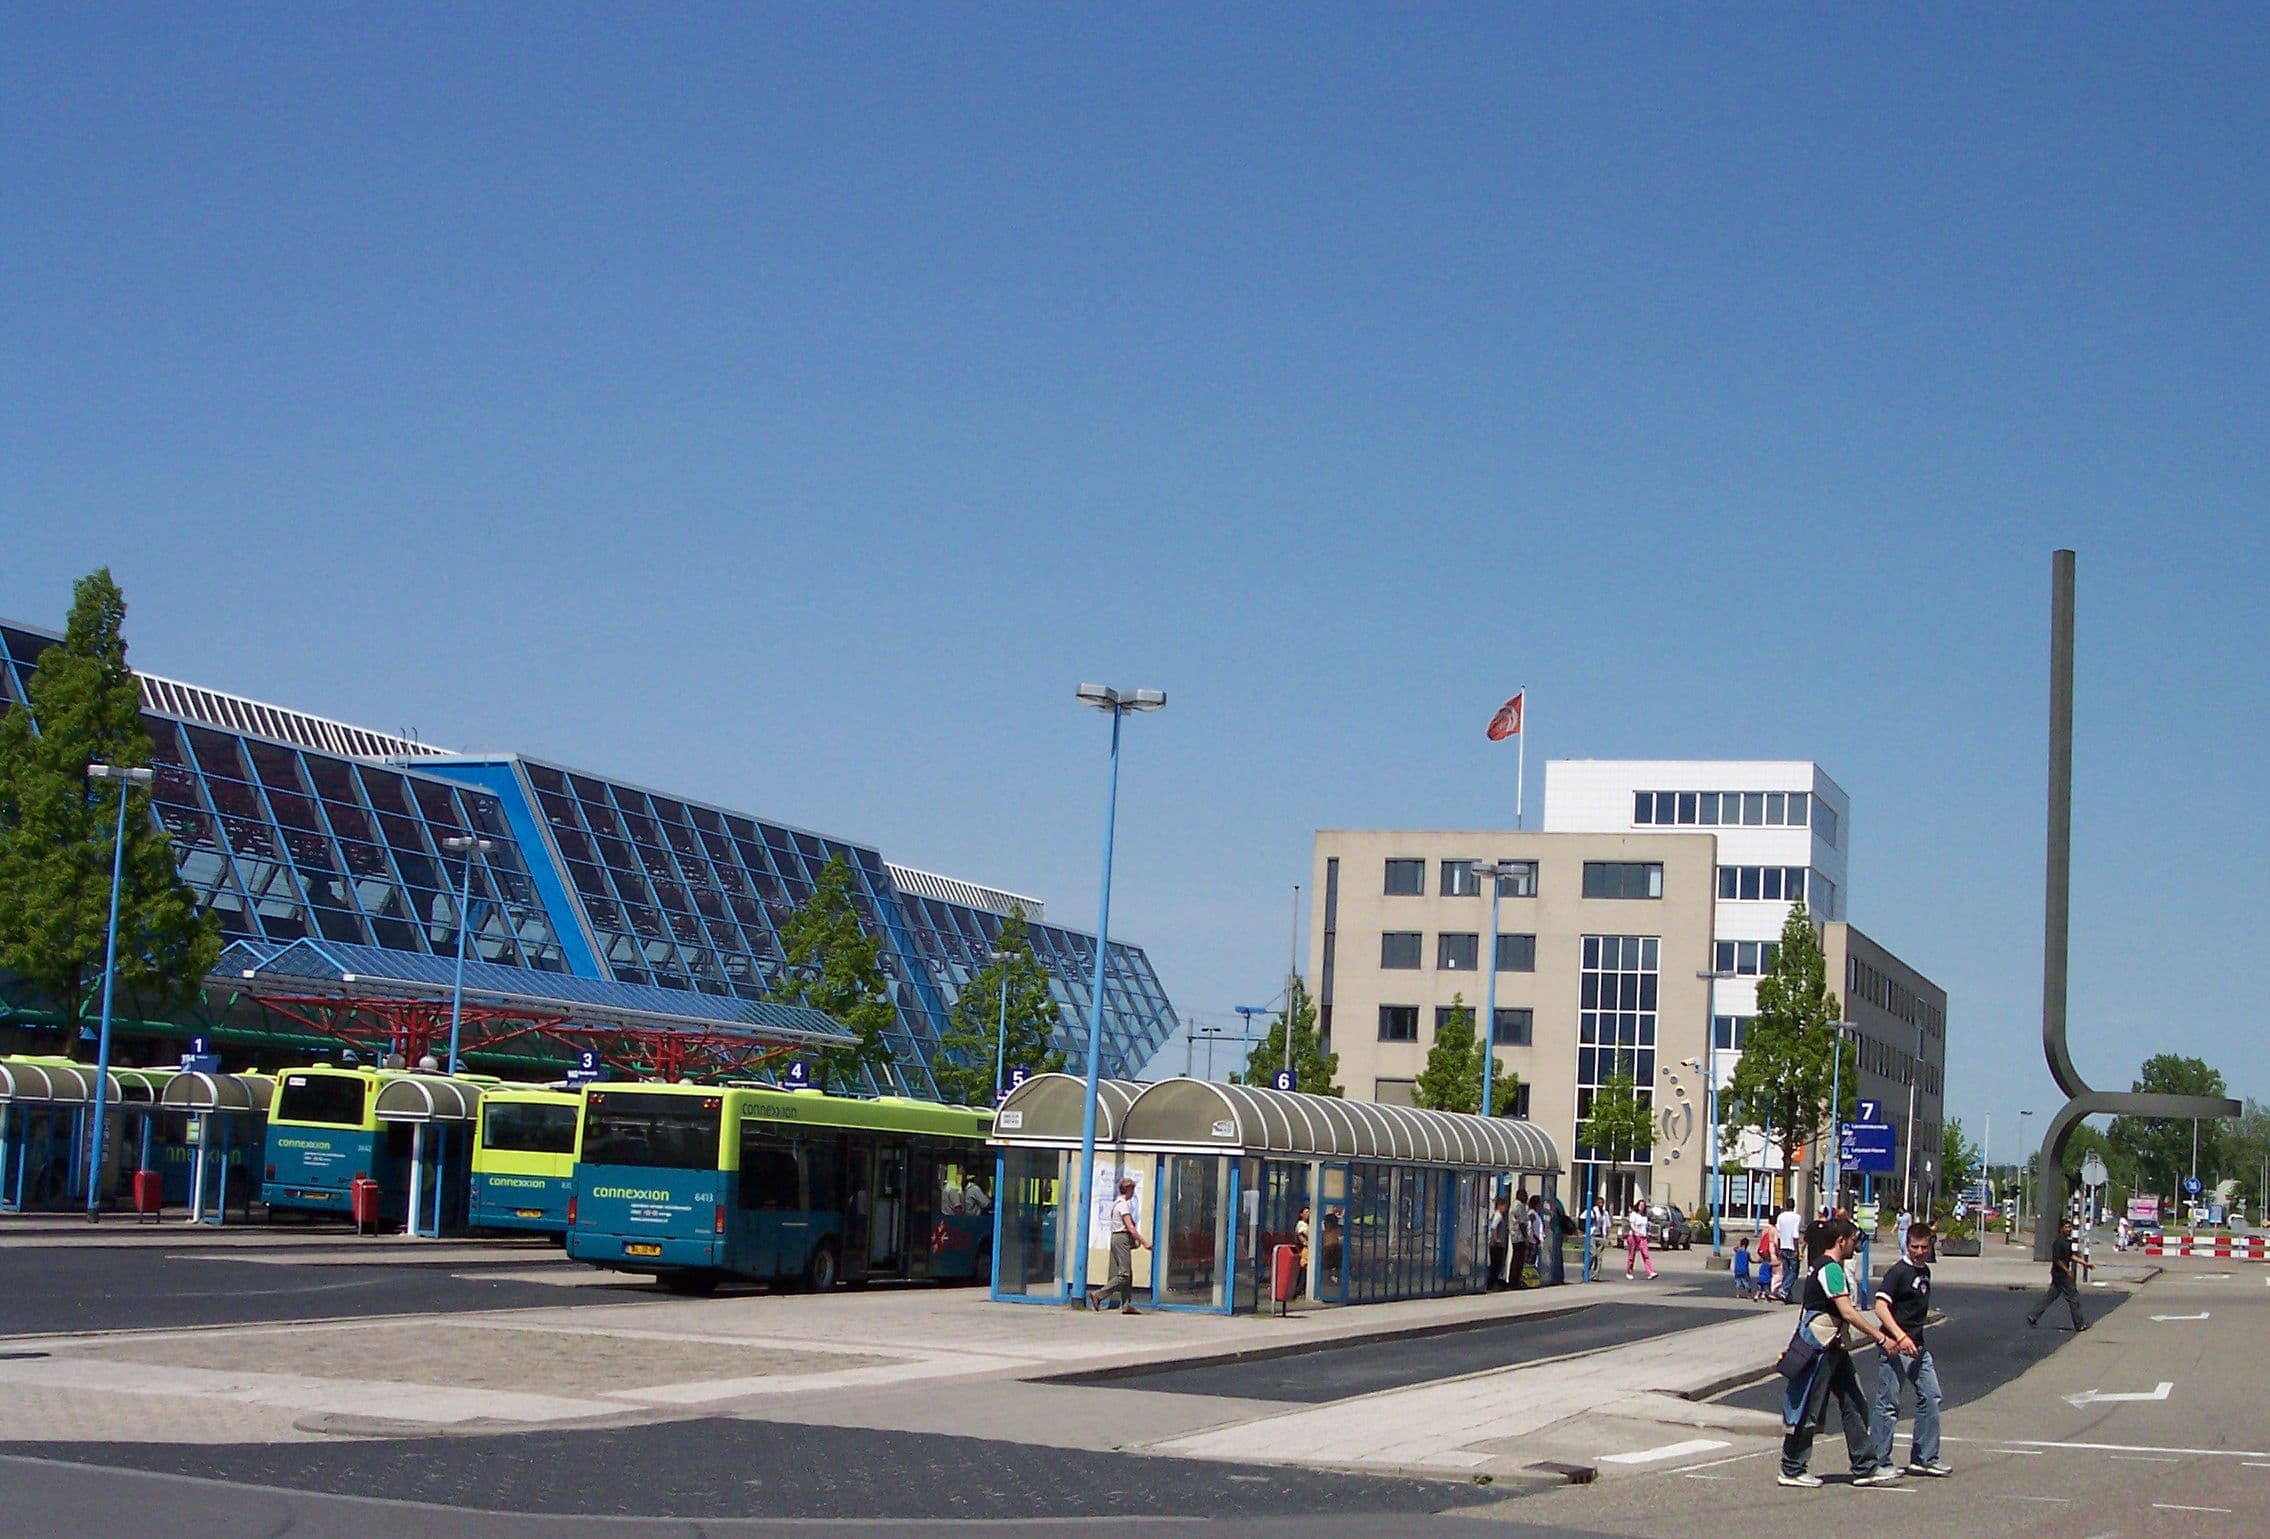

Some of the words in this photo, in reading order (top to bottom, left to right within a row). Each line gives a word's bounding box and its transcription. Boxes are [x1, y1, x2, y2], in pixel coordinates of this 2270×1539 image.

[194, 1038, 202, 1053] 1
[582, 1053, 593, 1068] 3
[791, 1063, 802, 1079] 4
[1012, 1070, 1024, 1087] 5
[1278, 1073, 1290, 1090] 6
[1861, 1102, 1874, 1120] 7
[278, 1139, 331, 1150] connexxion
[488, 1177, 546, 1189] connexxion
[593, 1186, 670, 1201] connexxion
